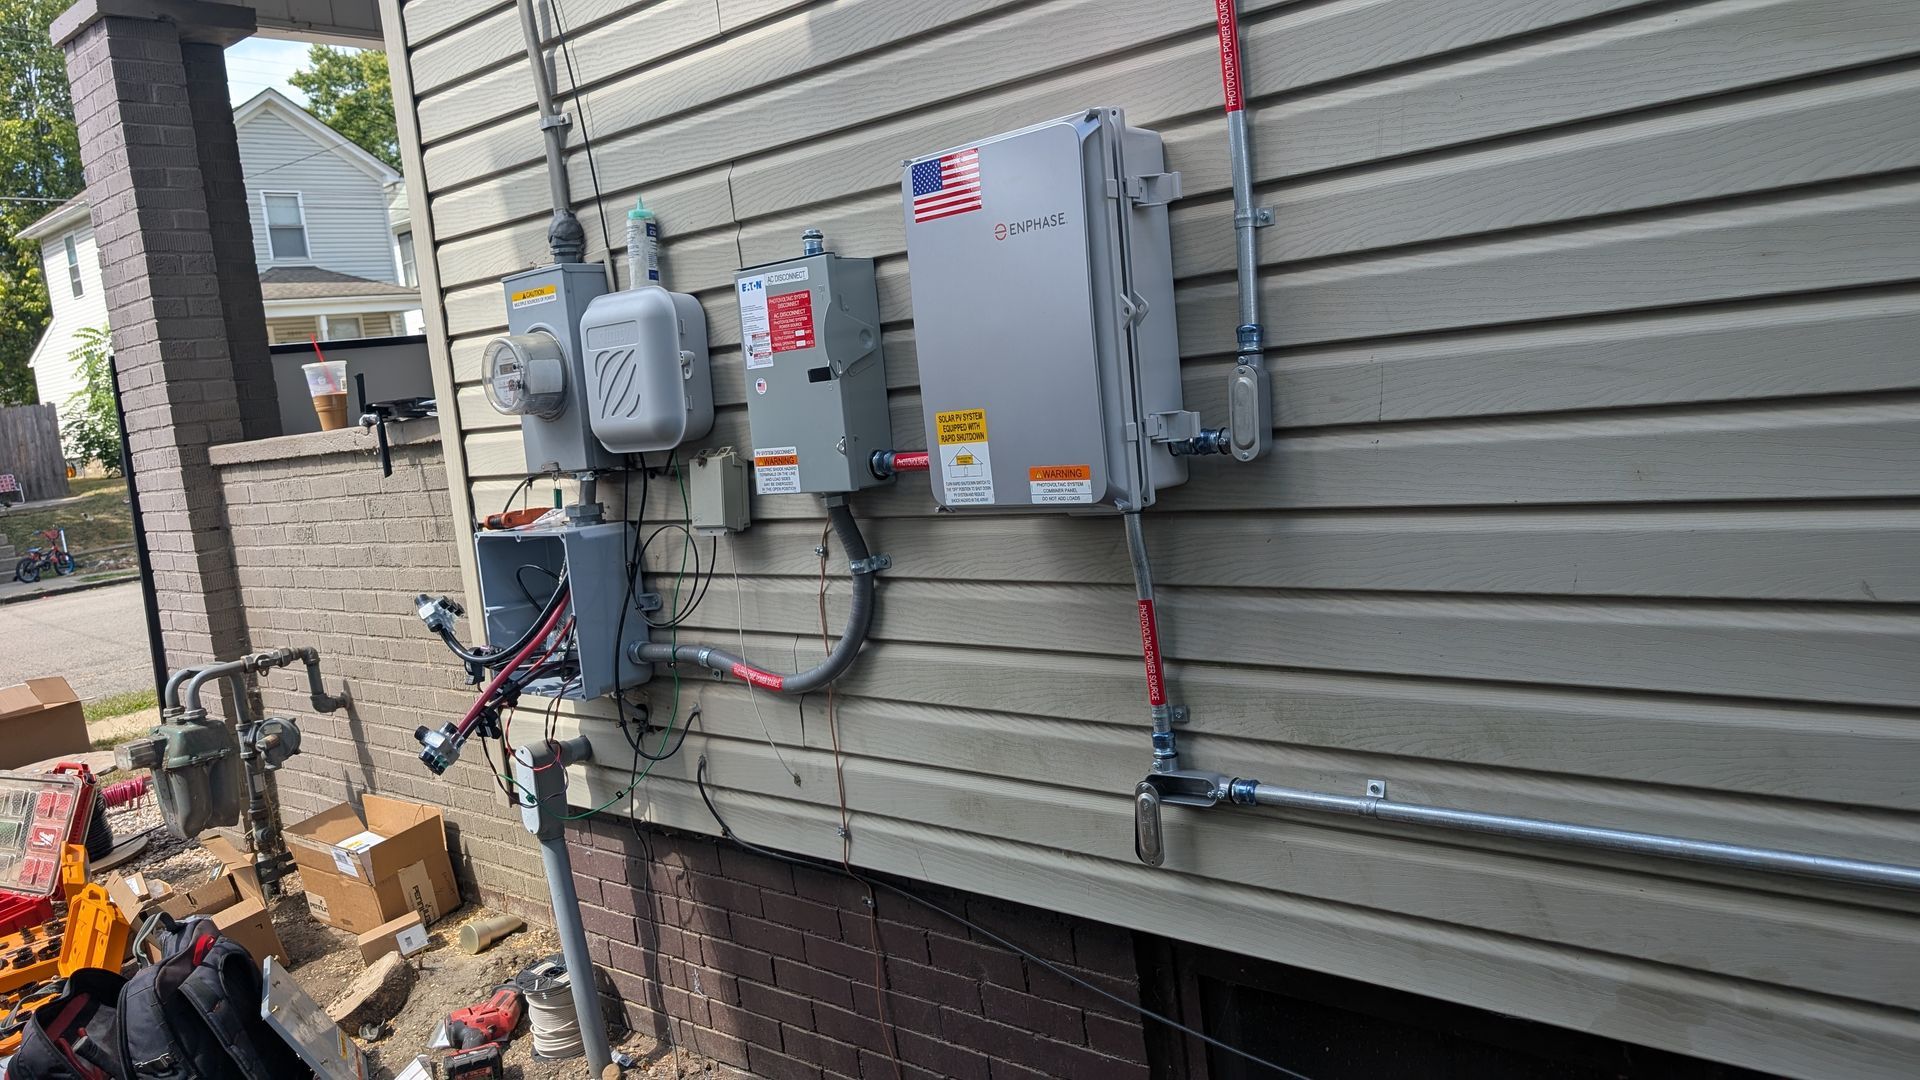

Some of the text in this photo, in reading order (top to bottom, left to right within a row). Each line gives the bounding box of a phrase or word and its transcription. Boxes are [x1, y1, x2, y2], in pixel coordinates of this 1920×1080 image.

[1219, 0, 1236, 106] PHOTOVOLTAIC POWER SOURC
[1009, 212, 1066, 235] ENPHASE
[775, 271, 805, 282] DISCONNECT
[526, 289, 545, 298] CAUTION
[769, 296, 793, 304] PHOTOVOLTAIC
[778, 300, 799, 309] DISCONNECT
[780, 309, 806, 317] DISCONNECT
[938, 412, 983, 423] SOLAR PV SYSTEM
[943, 422, 980, 432] EQUIPPED WITH
[941, 432, 985, 442] RAPID SHUTDOWN
[764, 456, 795, 465] WARNING
[897, 458, 928, 466] PHOTOVOLTAIC
[1042, 469, 1082, 478] WARNING
[1140, 604, 1160, 701] PHOTOVOLTAIC POWER SOURCE
